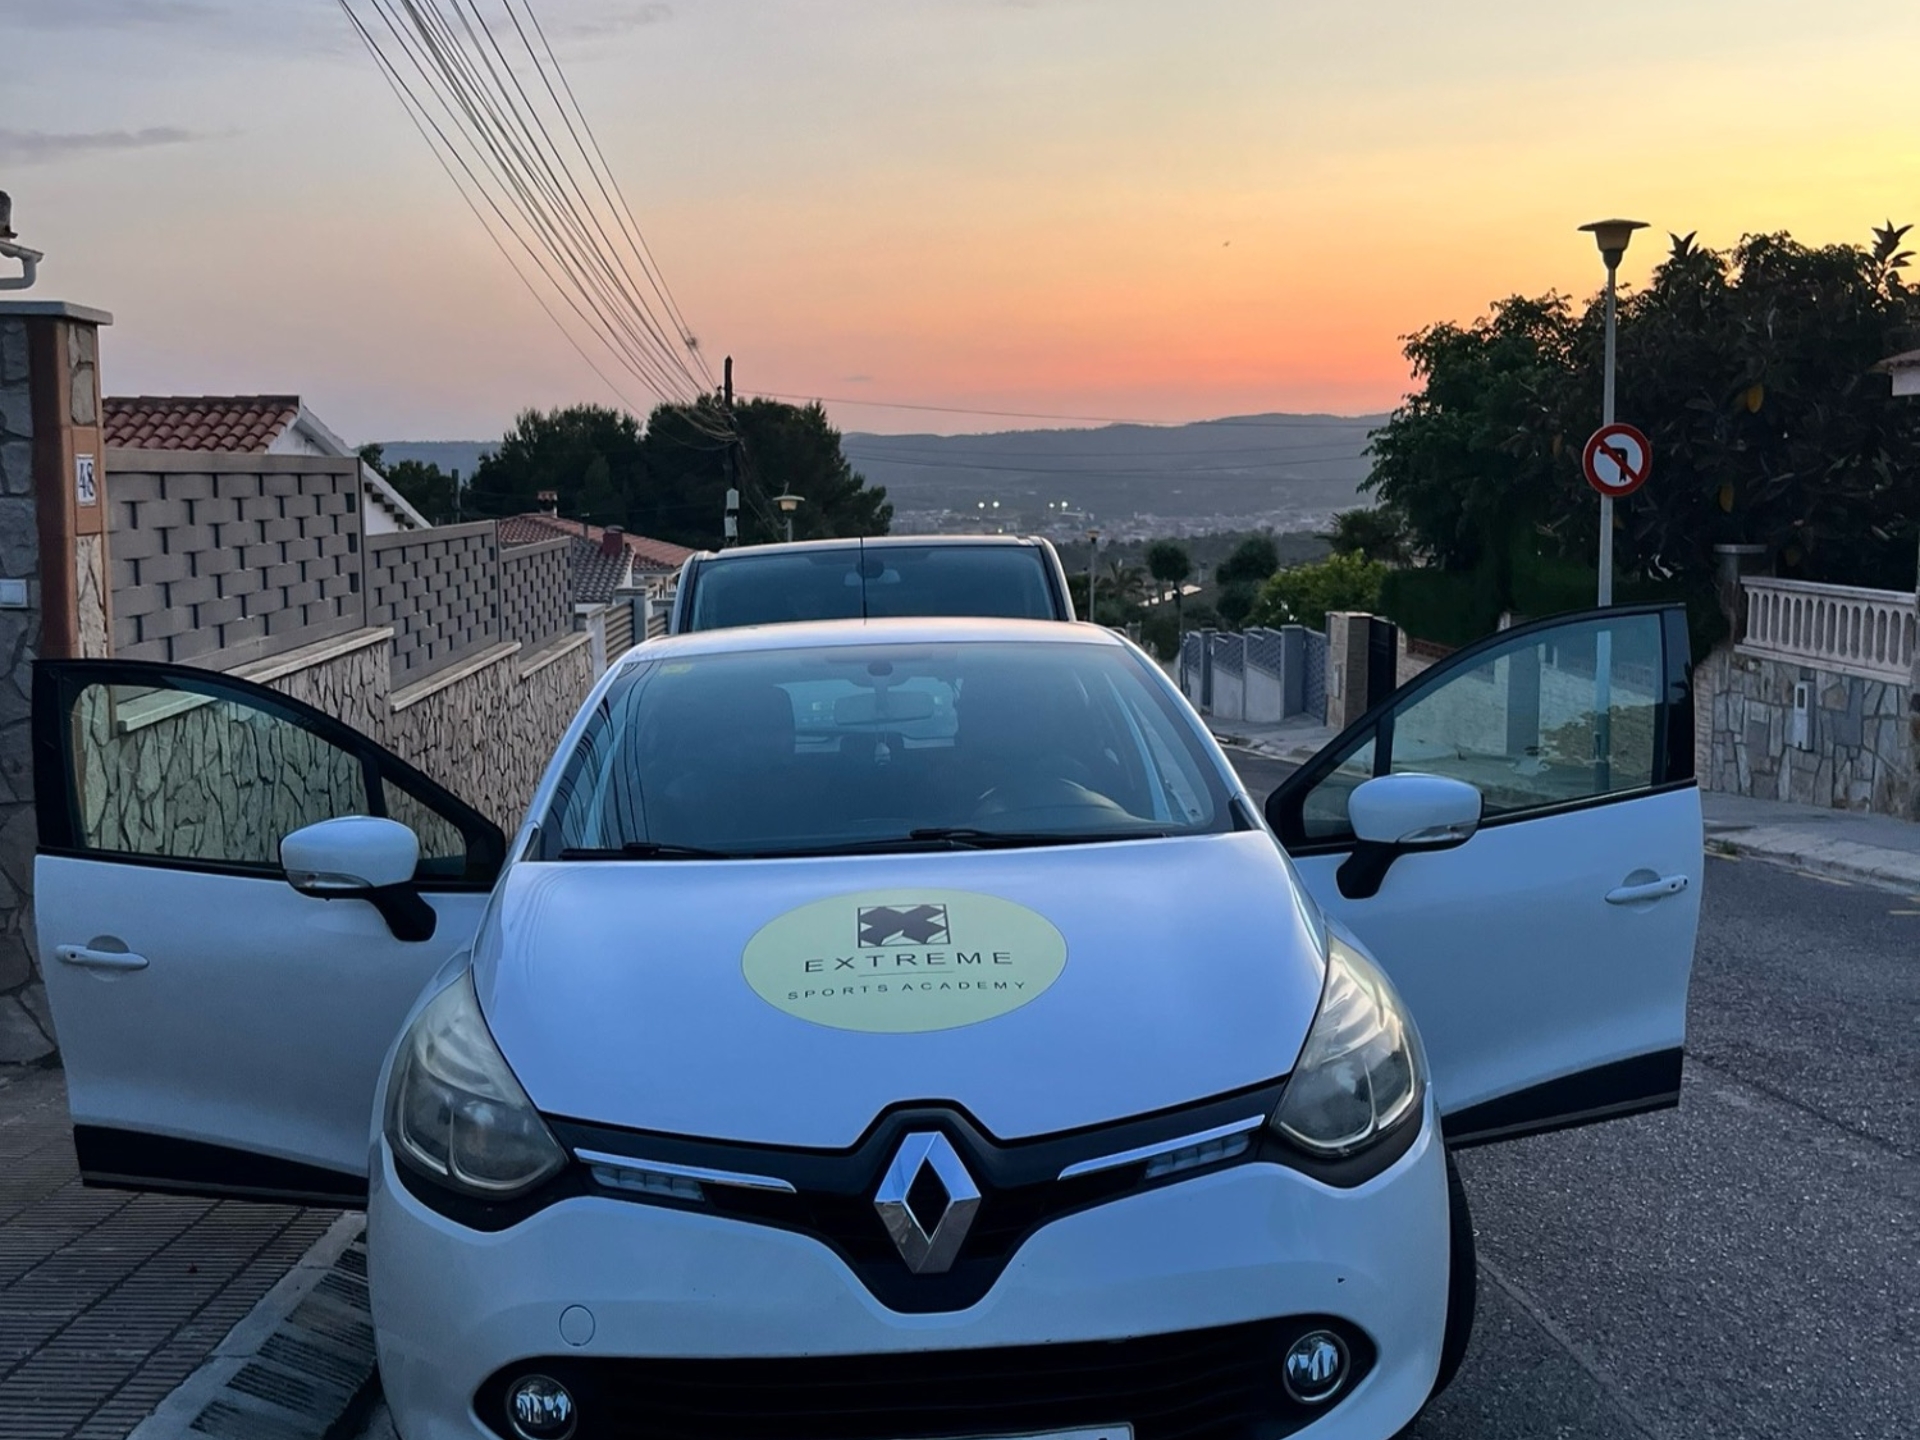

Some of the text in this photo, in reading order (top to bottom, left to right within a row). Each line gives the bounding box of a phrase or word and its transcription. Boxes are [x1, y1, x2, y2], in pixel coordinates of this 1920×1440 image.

[79, 462, 96, 498] 48
[804, 951, 1013, 973] EXTREME
[787, 980, 1026, 1001] SPORTS ACADEMY
